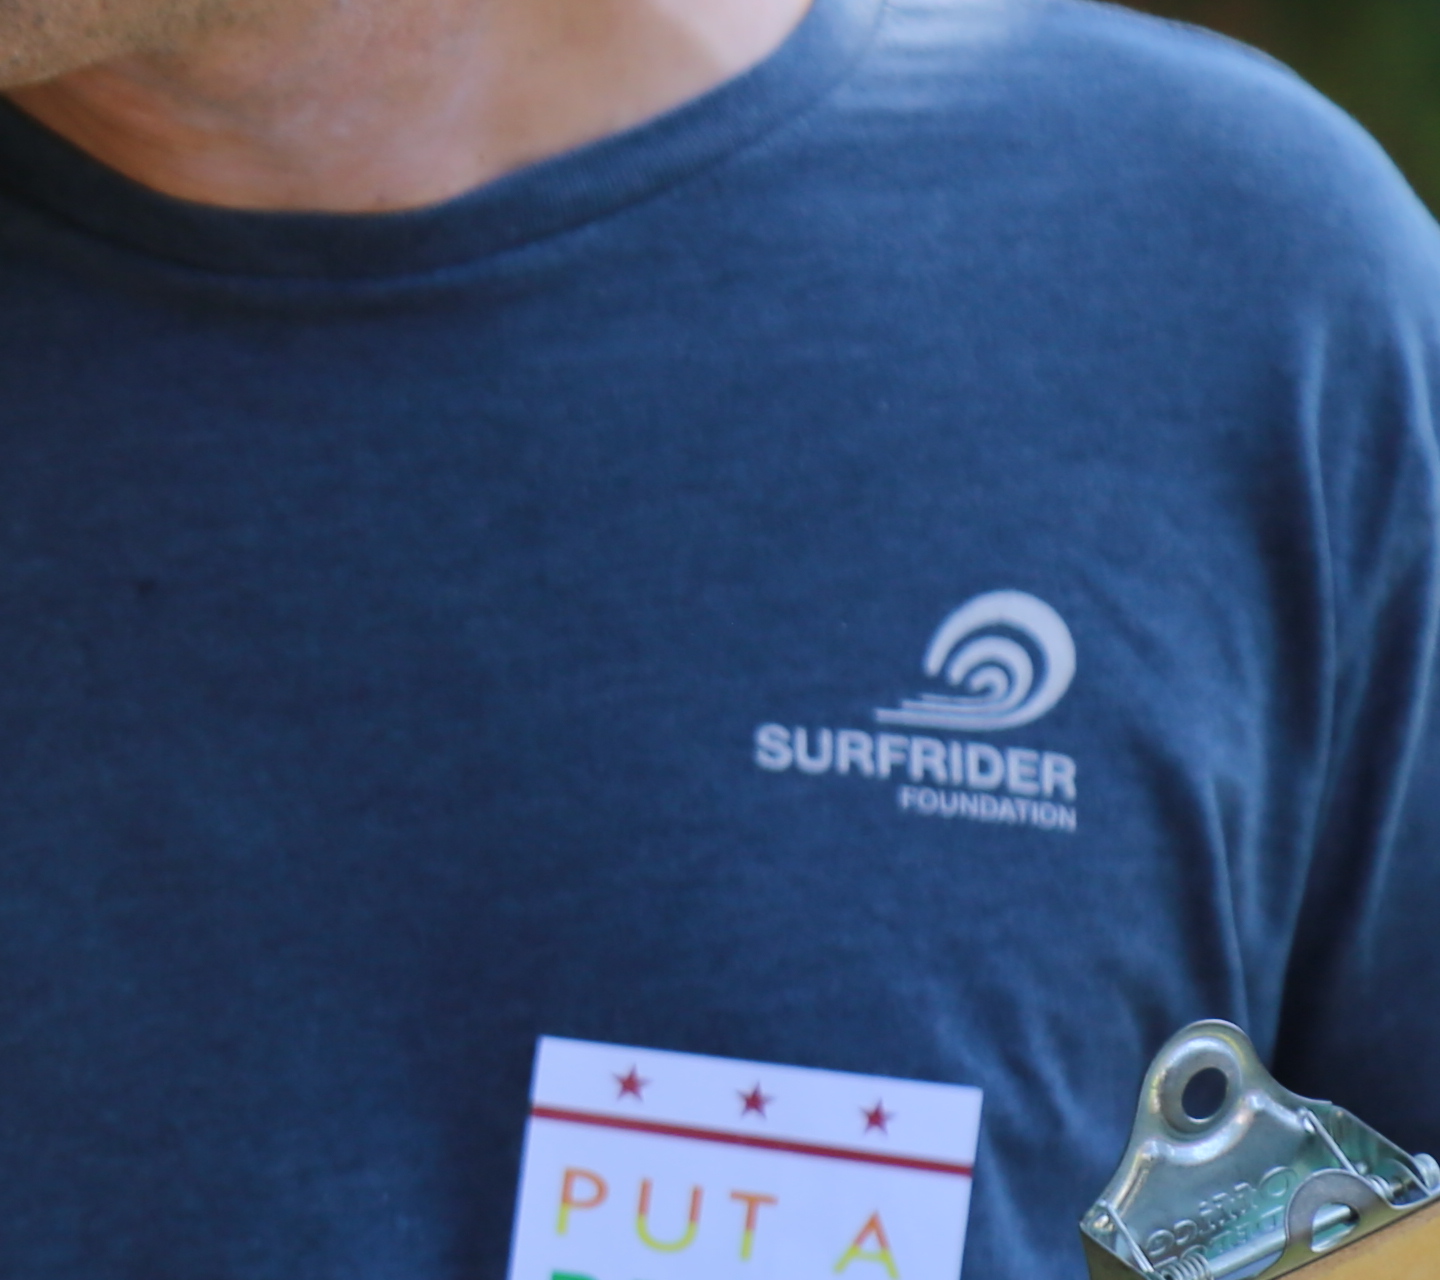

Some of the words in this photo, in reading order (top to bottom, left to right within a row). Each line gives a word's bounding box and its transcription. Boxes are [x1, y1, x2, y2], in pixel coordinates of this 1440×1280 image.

[754, 722, 1078, 802] SURFRIDER
[899, 785, 1078, 834] FOUNDATION
[555, 1166, 779, 1262] PUT
